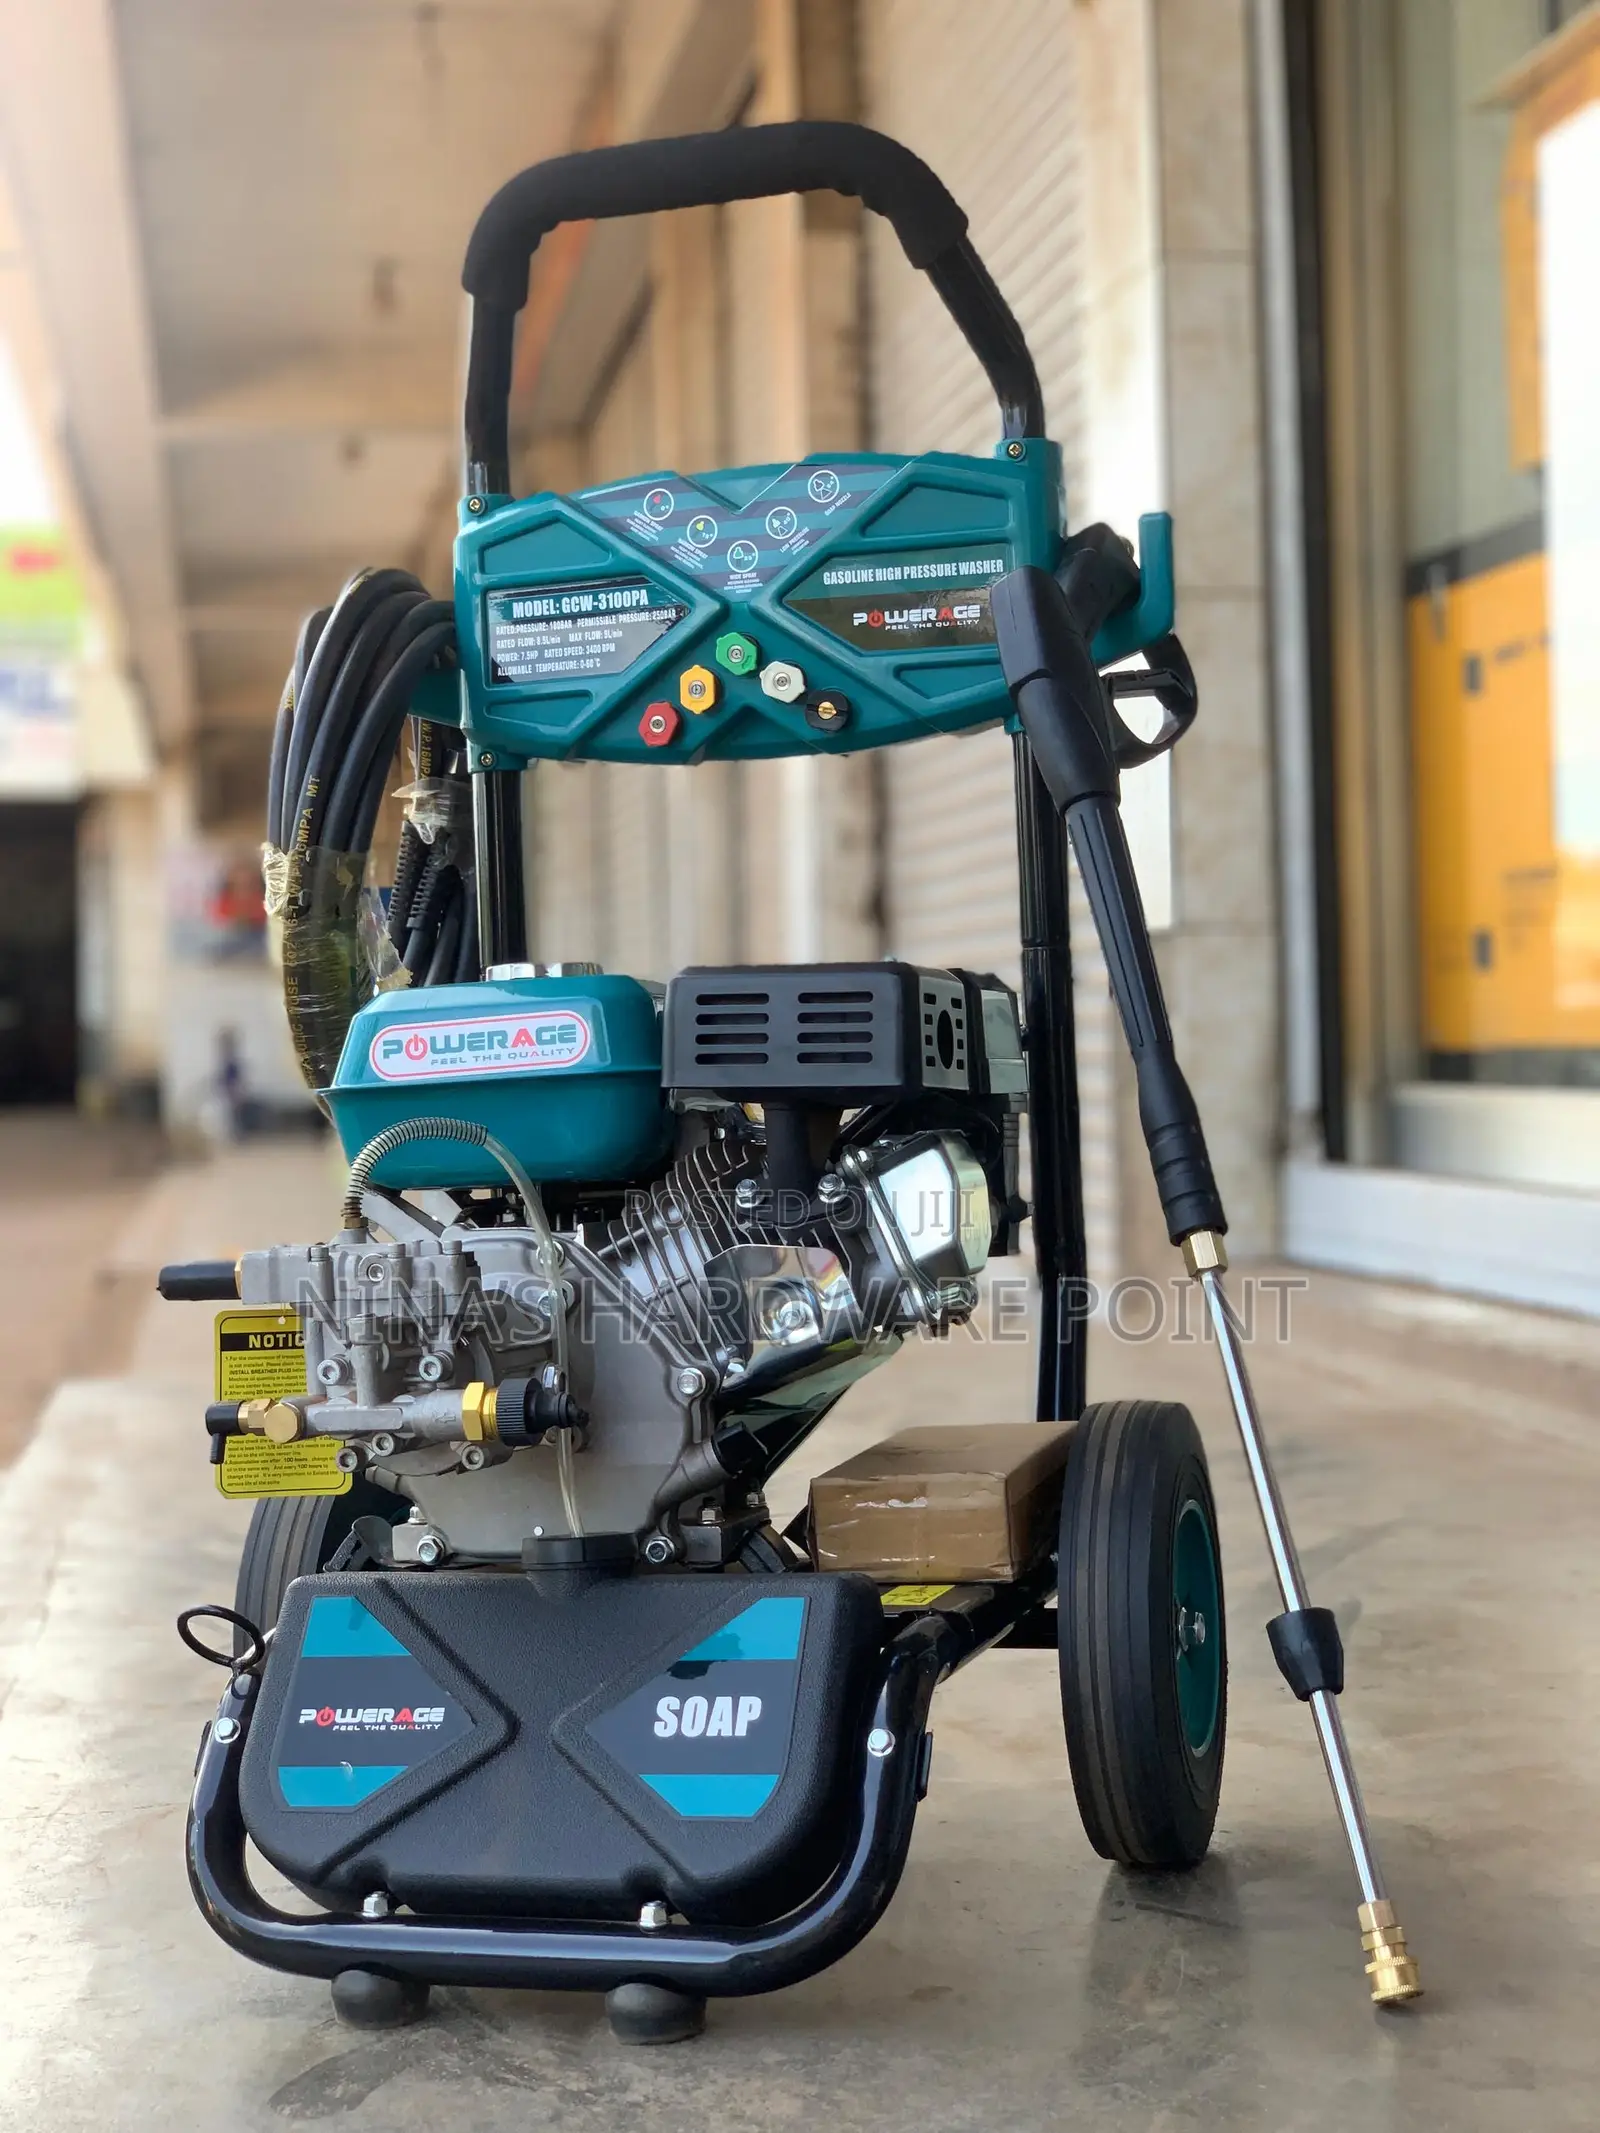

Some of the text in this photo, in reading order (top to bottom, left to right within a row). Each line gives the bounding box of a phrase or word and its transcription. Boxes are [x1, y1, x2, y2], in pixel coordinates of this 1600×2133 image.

[823, 559, 1004, 586] GASOLINE HIGH PRESSURE WASHER
[512, 589, 649, 618] MODEL: GCW-3100PA
[577, 614, 616, 628] PERMISSIBLE
[618, 611, 652, 623] PRESSURE:
[853, 604, 981, 627] POWERAGE
[935, 619, 980, 628] QUALITY
[496, 639, 516, 649] RATED
[517, 637, 536, 647] FLOW:
[568, 631, 583, 642] MAX
[585, 630, 603, 640] FLOW:
[496, 652, 520, 662] POWER:
[521, 650, 539, 661] 7.5HP
[544, 647, 563, 658] RATED
[564, 645, 585, 656] SPEED:
[601, 642, 616, 653] RPM
[497, 664, 532, 677] ALLOWABLE
[535, 660, 579, 673] TEMPERATURE:
[306, 774, 321, 798] MT
[382, 1023, 577, 1061] POWERAGE
[430, 1047, 576, 1066] FEEL THE QUALITY
[248, 1333, 304, 1349] NOTIC
[298, 1705, 446, 1727] POWERAGE
[653, 1695, 762, 1738] SOAP
[390, 1723, 441, 1731] QUALITY
